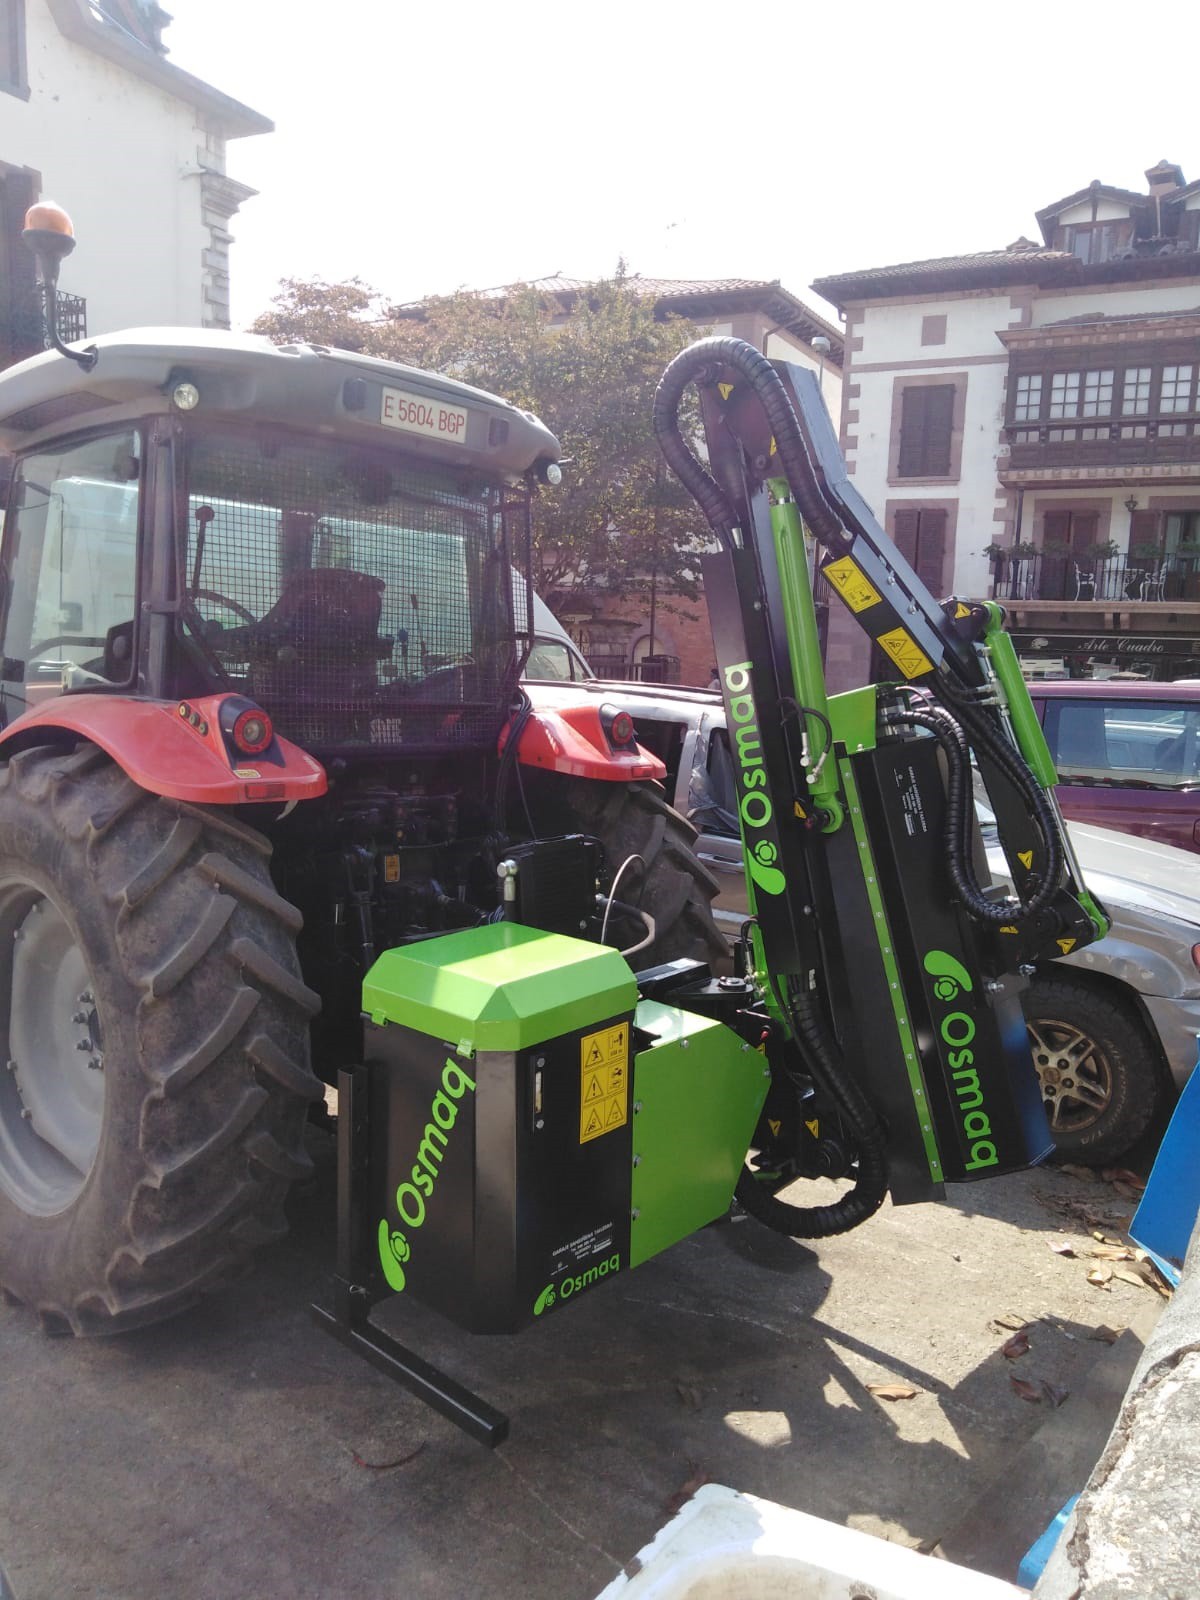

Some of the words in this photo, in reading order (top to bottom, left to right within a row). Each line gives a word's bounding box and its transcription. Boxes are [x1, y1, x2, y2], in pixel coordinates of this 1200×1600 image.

[384, 395, 394, 418] E
[398, 400, 434, 428] 5604
[438, 410, 465, 435] BGP
[1078, 638, 1109, 651] Arte
[1116, 638, 1164, 652] Cuadro
[724, 661, 773, 828] Osmaq
[941, 1012, 999, 1171] Osmaq
[396, 1058, 477, 1228] Osmaq
[560, 1253, 620, 1299] Osmaq
